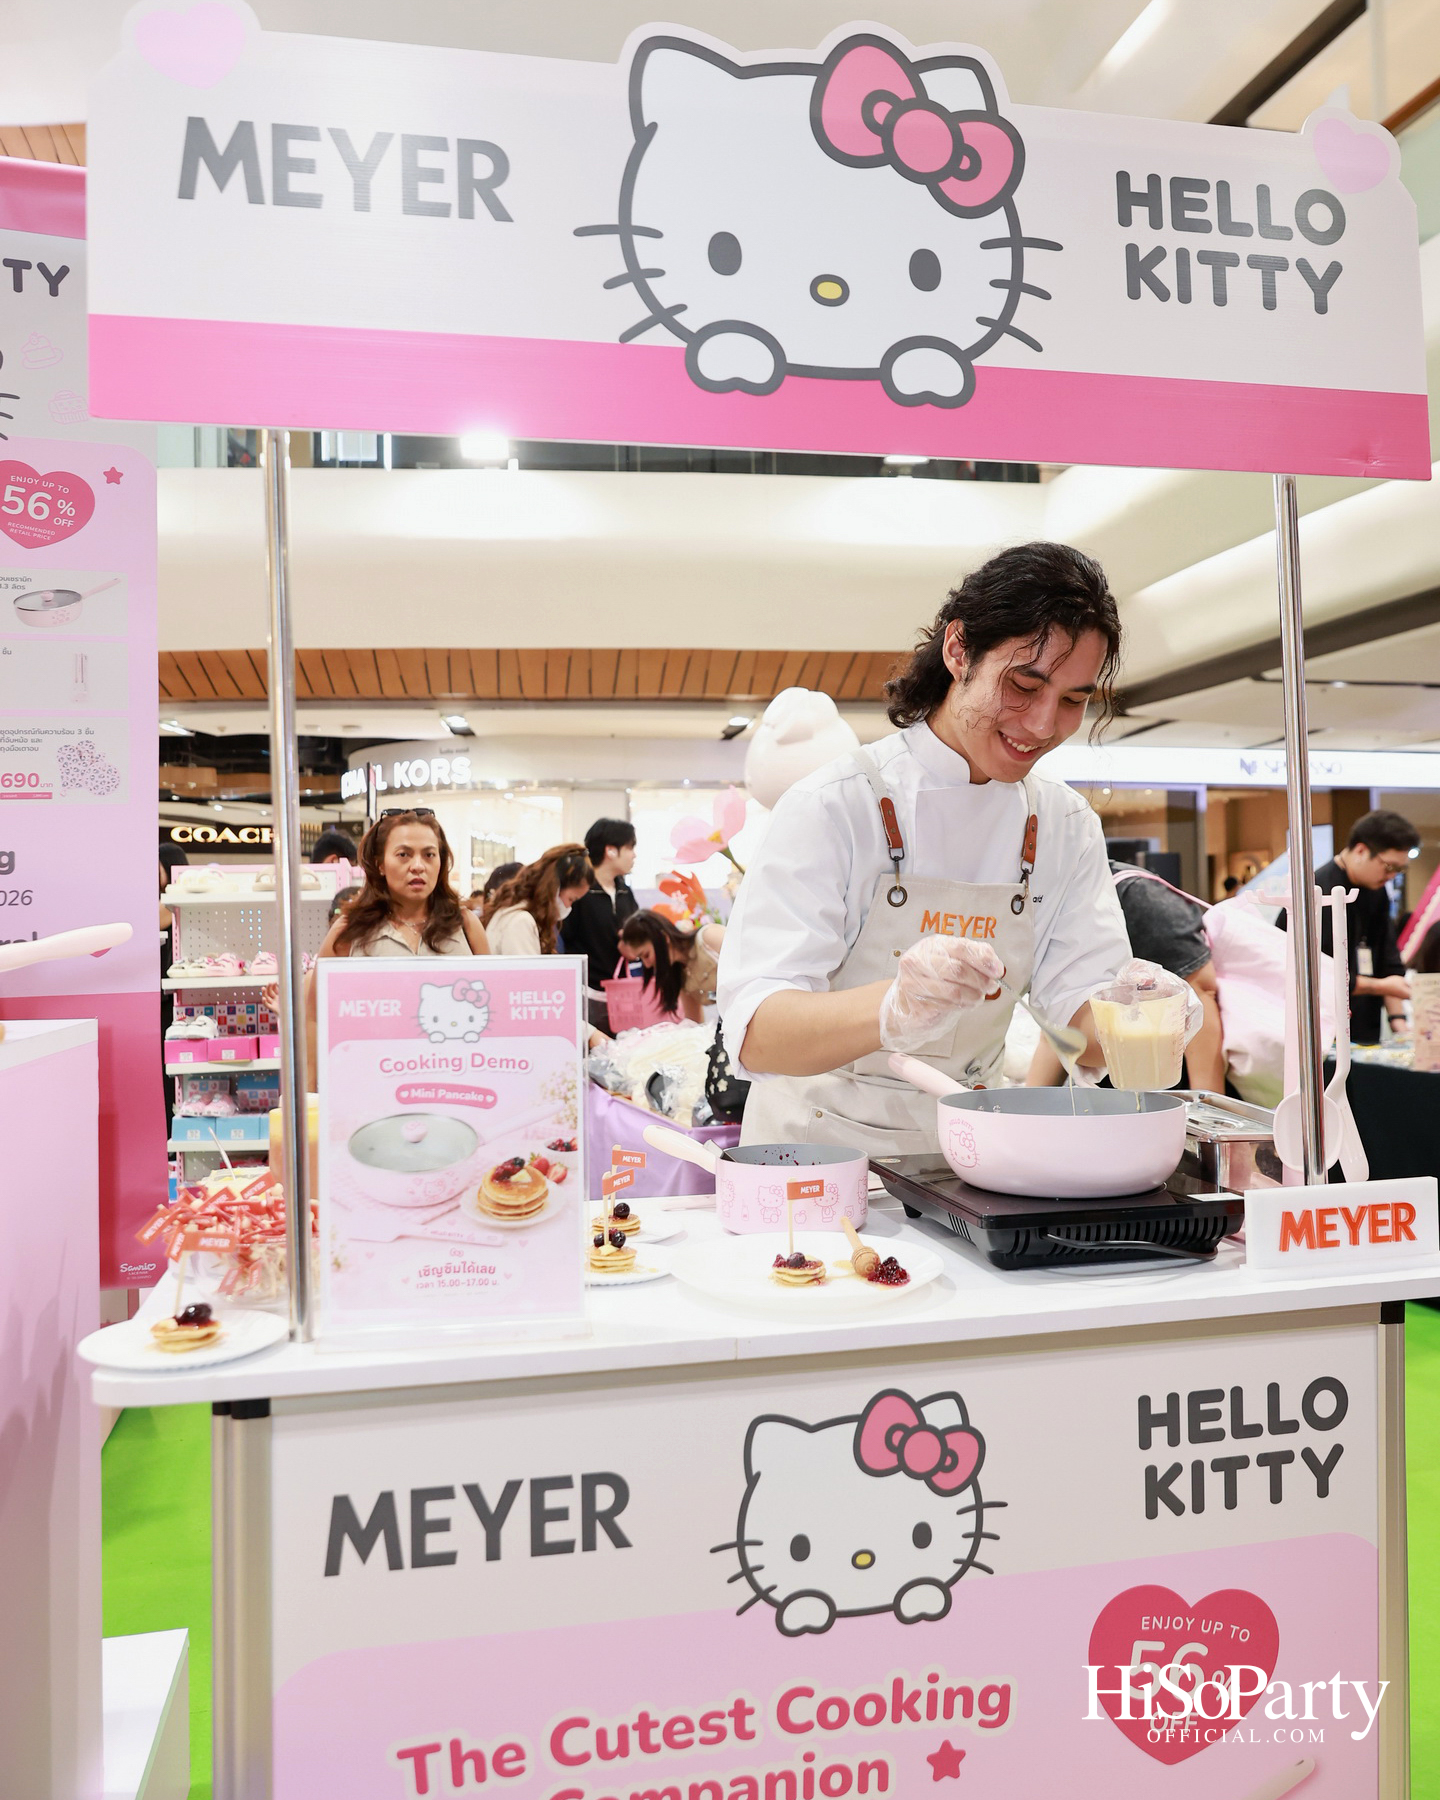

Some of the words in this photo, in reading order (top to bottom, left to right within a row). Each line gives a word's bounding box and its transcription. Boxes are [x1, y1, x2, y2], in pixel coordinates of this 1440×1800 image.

[177, 116, 515, 223] MEYER
[1115, 170, 1347, 246] HELLO
[1125, 242, 1343, 315] KITTY
[10, 475, 40, 485] ENJOY
[42, 480, 55, 489] UP
[57, 484, 70, 494] TO
[7, 521, 56, 536] RECOMMENDED
[53, 517, 75, 528] OFF
[9, 527, 32, 537] RETAIL
[32, 532, 52, 541] PRICE
[394, 756, 472, 789] KORS
[920, 909, 997, 939] MEYER
[508, 990, 566, 1005] HELLO
[339, 999, 402, 1018] MEYER
[510, 1006, 565, 1021] KITTY
[379, 1053, 463, 1073] Cooking
[470, 1052, 530, 1071] Demo
[410, 1088, 435, 1099] Mini
[437, 1088, 484, 1103] Pancake
[622, 1155, 642, 1164] MEYER
[612, 1174, 631, 1188] MEYER
[800, 1184, 820, 1195] MEYER
[1279, 1202, 1418, 1253] MEYER
[199, 1236, 231, 1248] MEYER
[1137, 1376, 1349, 1451] HELLO
[1144, 1443, 1345, 1520] KITTY
[324, 1471, 633, 1577] MEYER
[1141, 1616, 1195, 1632] ENJOY
[1201, 1619, 1224, 1636] UP
[1230, 1624, 1251, 1643] TO
[396, 1737, 527, 1796] The
[549, 1697, 756, 1767] Cutest
[776, 1671, 1012, 1735] Cooking
